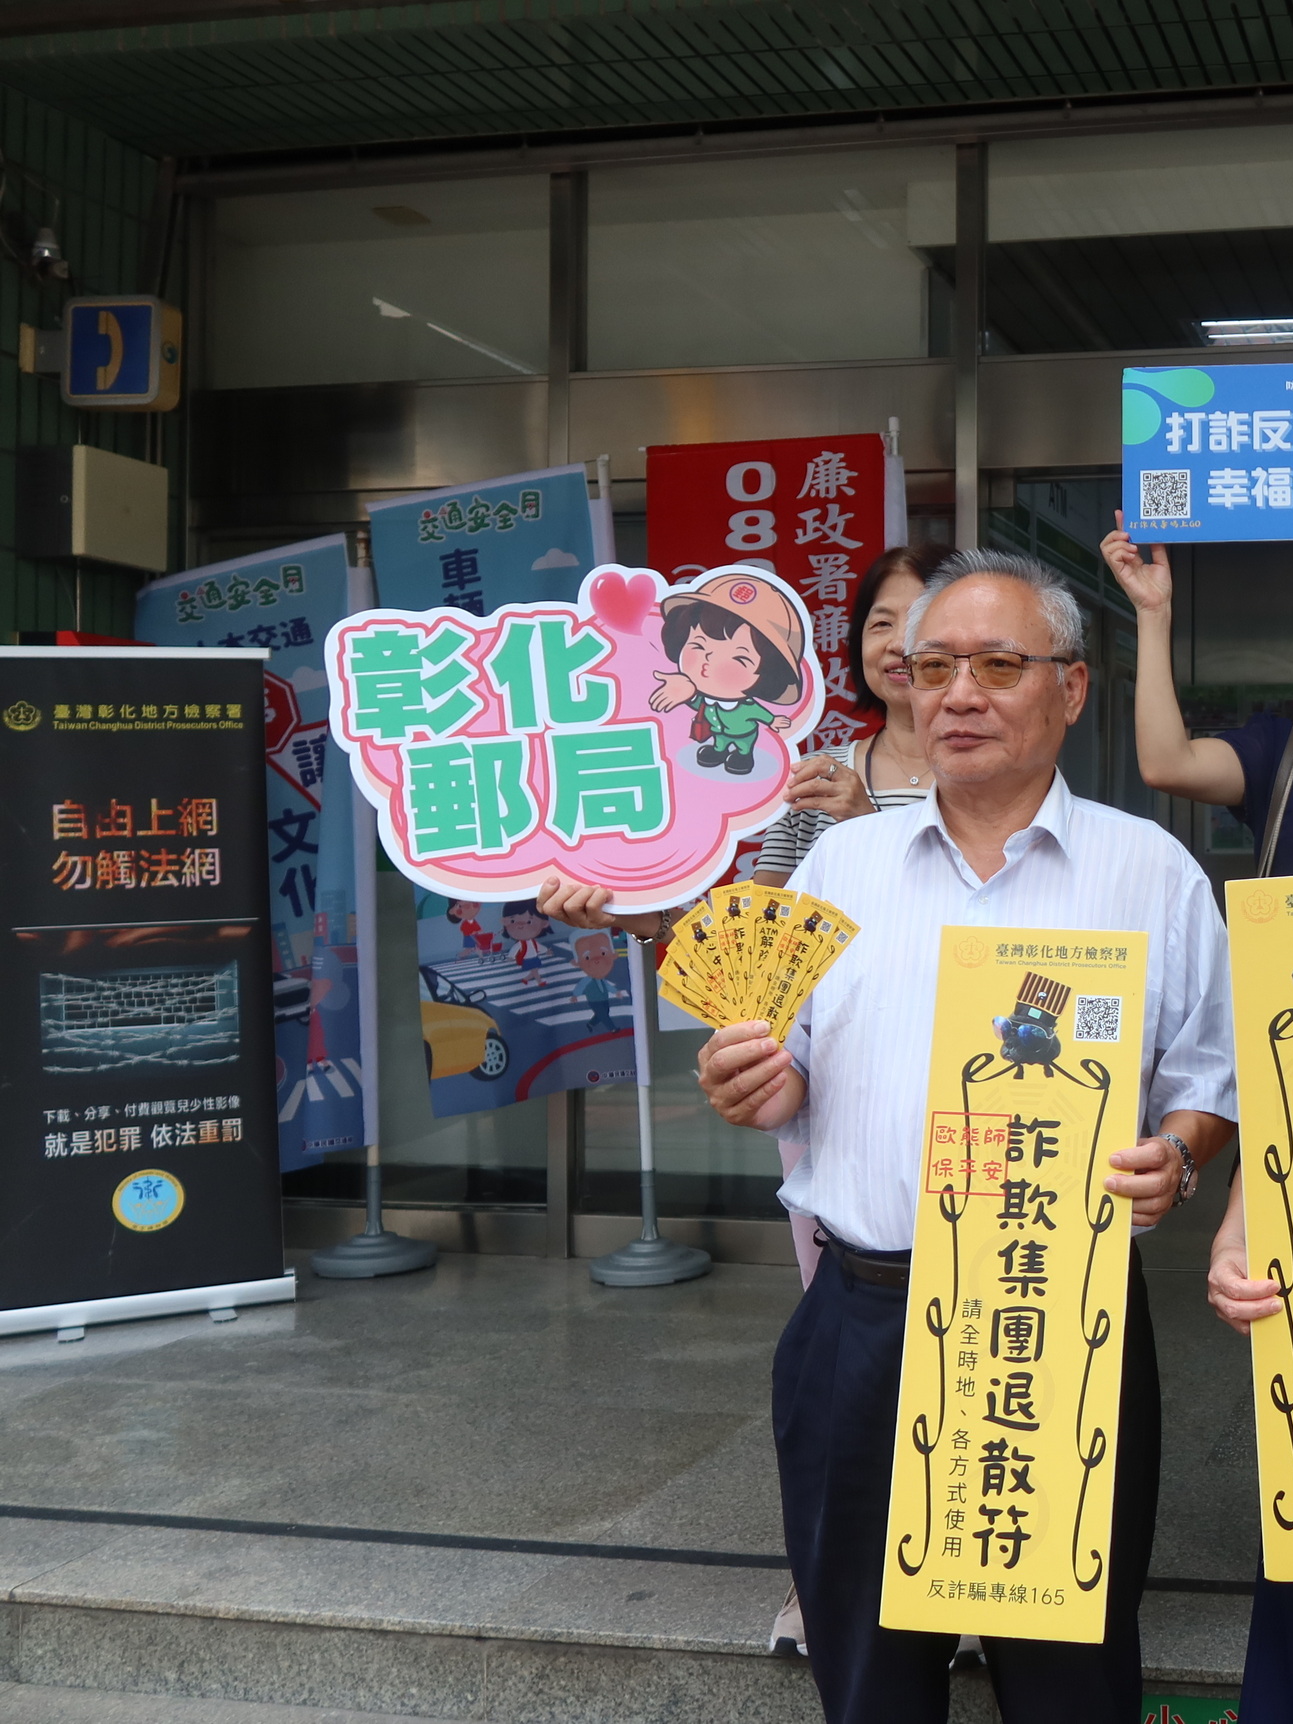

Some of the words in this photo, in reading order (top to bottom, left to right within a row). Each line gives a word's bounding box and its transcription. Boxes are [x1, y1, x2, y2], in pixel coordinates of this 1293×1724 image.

[418, 490, 542, 543] 交通安全月
[725, 461, 777, 574] 08
[177, 565, 305, 623] 交通安全月
[350, 620, 611, 740] 彰化
[53, 704, 243, 719] 臺灣彰化地方檢察署
[53, 721, 88, 730] Taiwan
[89, 721, 133, 732] Changhua
[134, 721, 165, 730] District
[167, 721, 218, 730] Prosecutors
[219, 721, 244, 730] Office
[406, 728, 664, 855] 郵局
[52, 798, 219, 841] 自由上網
[51, 848, 222, 890] 勿觸法網
[995, 943, 1128, 961] 臺灣彰化地方檢察署
[44, 1126, 142, 1158] 就是犯罪
[150, 1117, 243, 1149] 依法重罰
[935, 1126, 1006, 1147] 歐熊師
[932, 1158, 1003, 1181] 保平安
[972, 1114, 1061, 1570] 詐欺集團退散符
[942, 1298, 982, 1558] 請全時地、各方式使用
[927, 1579, 1065, 1606] 反詐騙專線165
